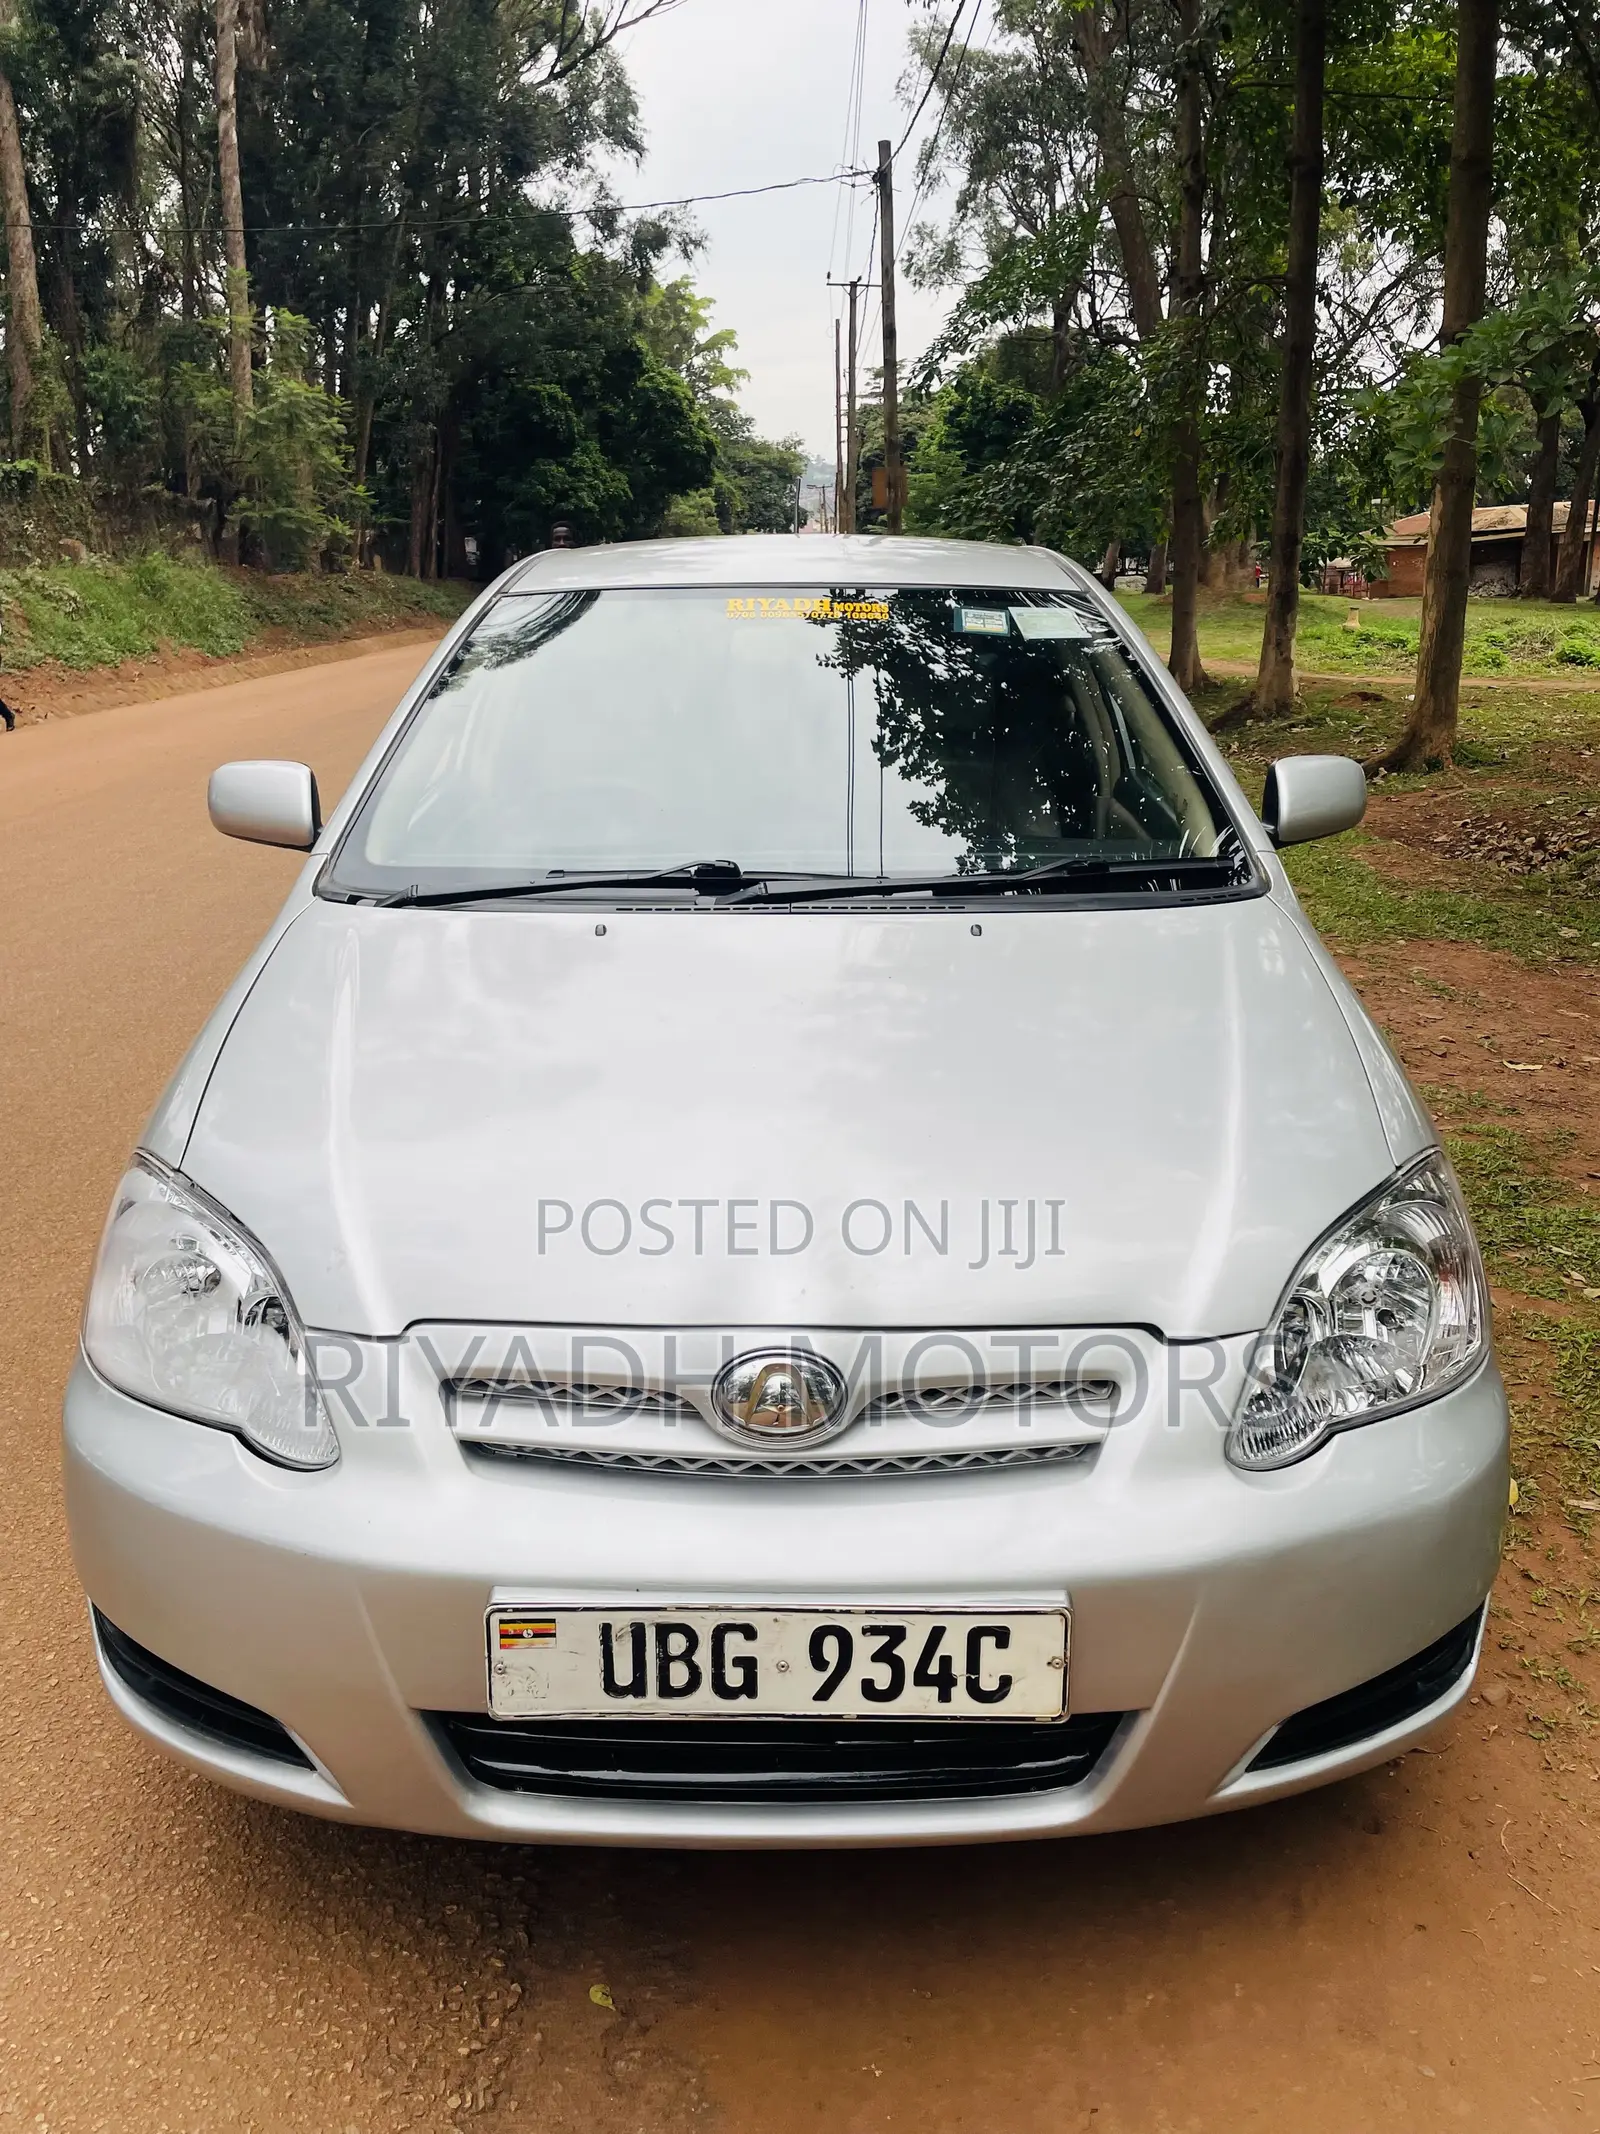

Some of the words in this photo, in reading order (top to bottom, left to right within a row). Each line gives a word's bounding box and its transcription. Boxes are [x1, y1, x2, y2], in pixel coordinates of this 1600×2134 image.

[727, 597, 831, 611] RIYADH
[834, 602, 888, 612] MOTORS
[598, 1621, 758, 1700] UBG
[809, 1624, 1012, 1704] 934C
